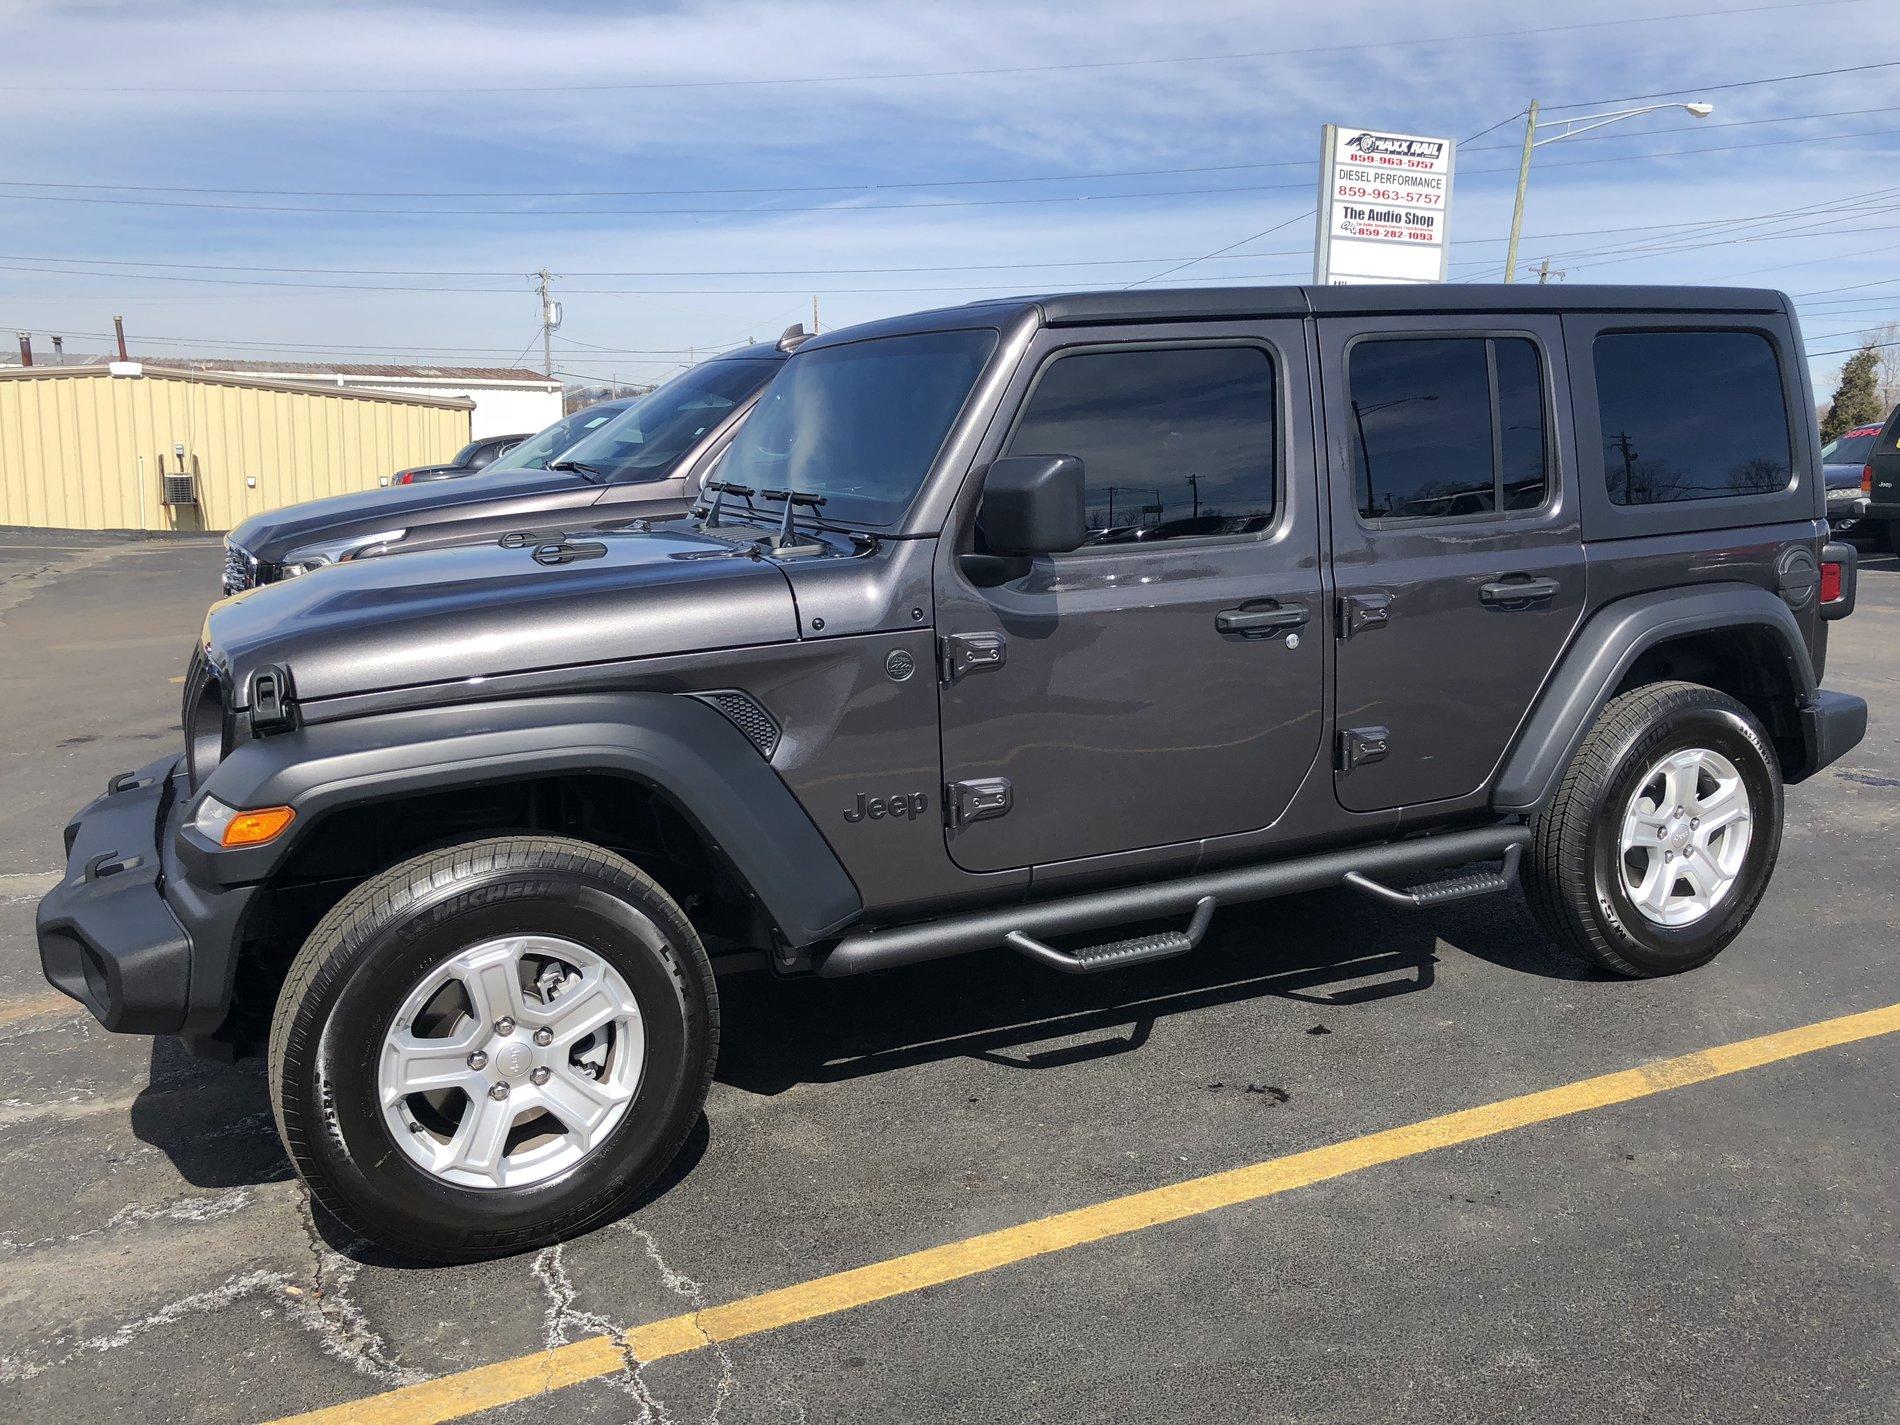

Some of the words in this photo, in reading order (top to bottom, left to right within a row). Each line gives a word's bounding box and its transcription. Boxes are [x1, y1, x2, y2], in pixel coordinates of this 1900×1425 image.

[1350, 153, 1434, 169] 859-963-5757
[1339, 169, 1371, 183] DIESEL
[1373, 172, 1442, 189] PERFORMANCE
[1338, 186, 1441, 204] 859-963-5757
[1343, 206, 1365, 220] The
[1367, 208, 1402, 224] Audio
[1404, 211, 1434, 227] Shop
[1358, 228, 1433, 241] 859-282-1093
[843, 792, 929, 823] Jeep
